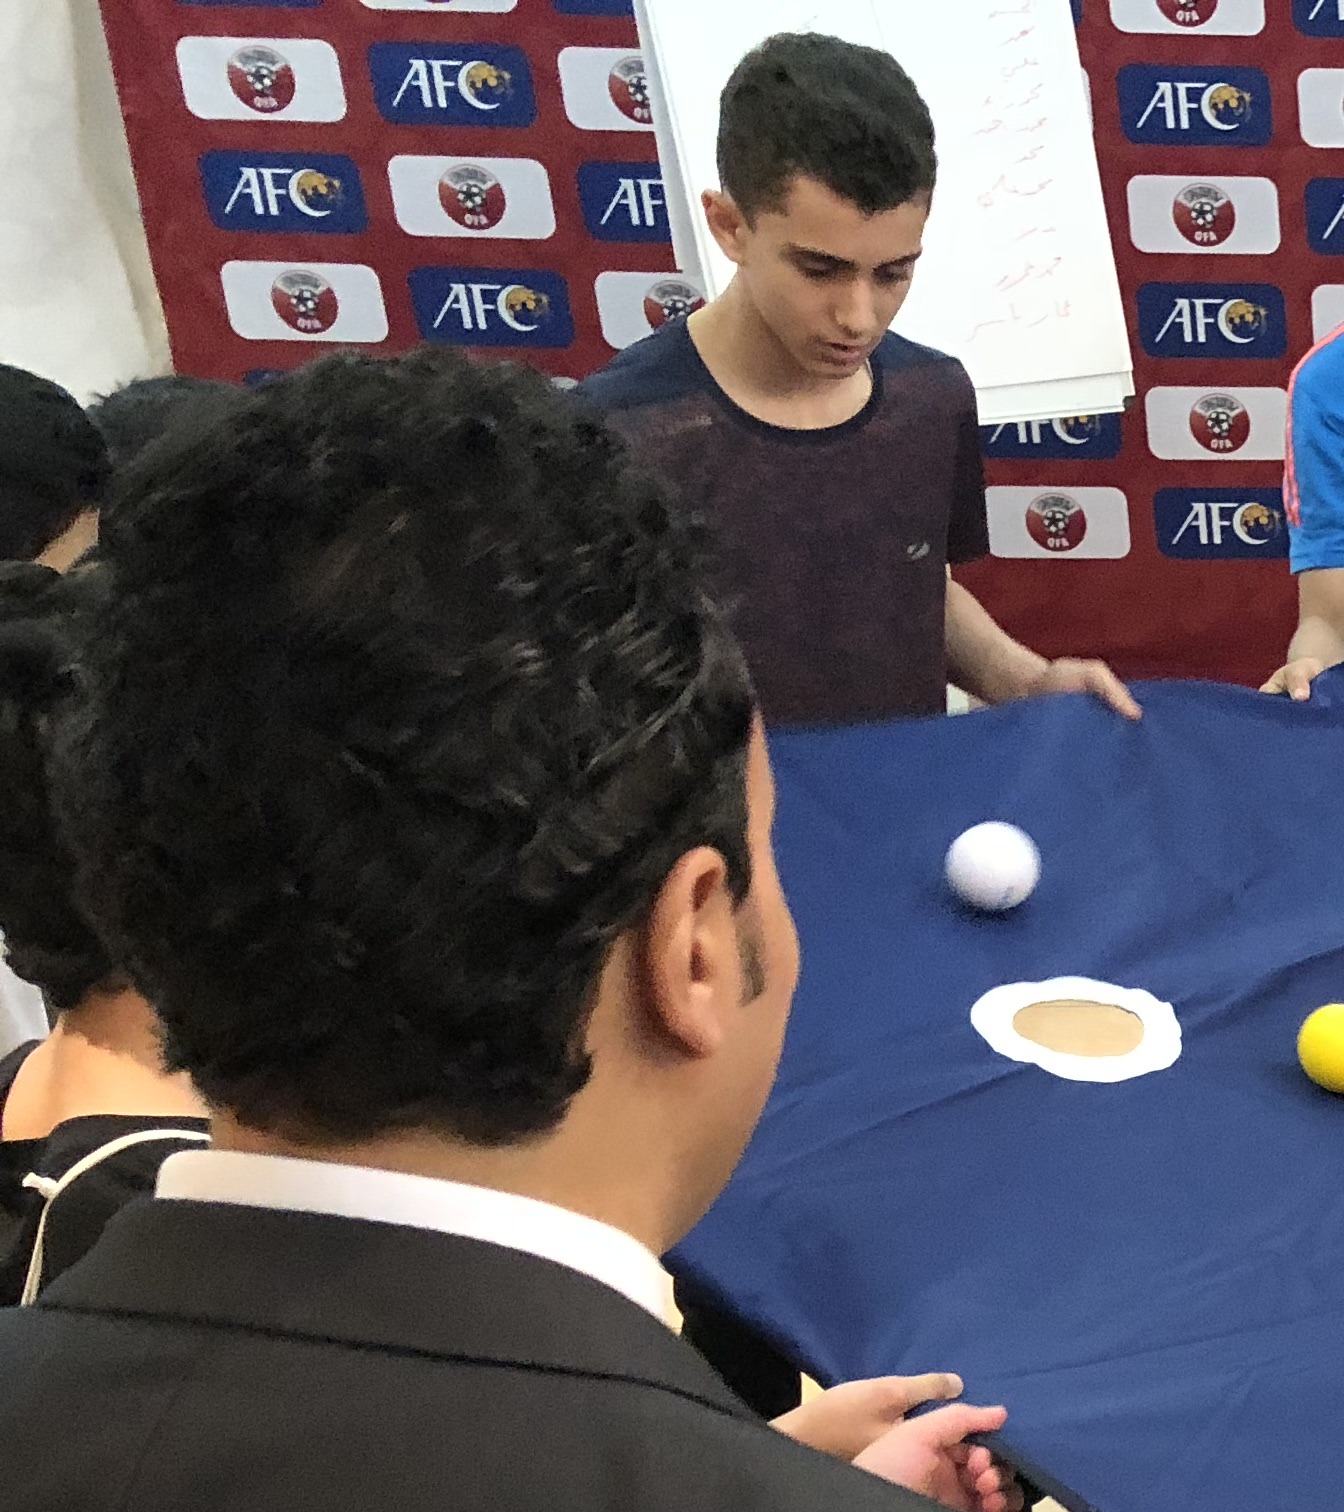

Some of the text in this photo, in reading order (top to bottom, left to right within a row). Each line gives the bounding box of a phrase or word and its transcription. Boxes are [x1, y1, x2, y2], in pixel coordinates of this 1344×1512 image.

[392, 59, 501, 110] AFC
[1136, 81, 1240, 131] AFC
[225, 167, 332, 217] AFC
[600, 178, 665, 227] AF
[432, 283, 539, 332] AFC
[1155, 298, 1255, 344] AFC
[1171, 502, 1269, 545] AFC
